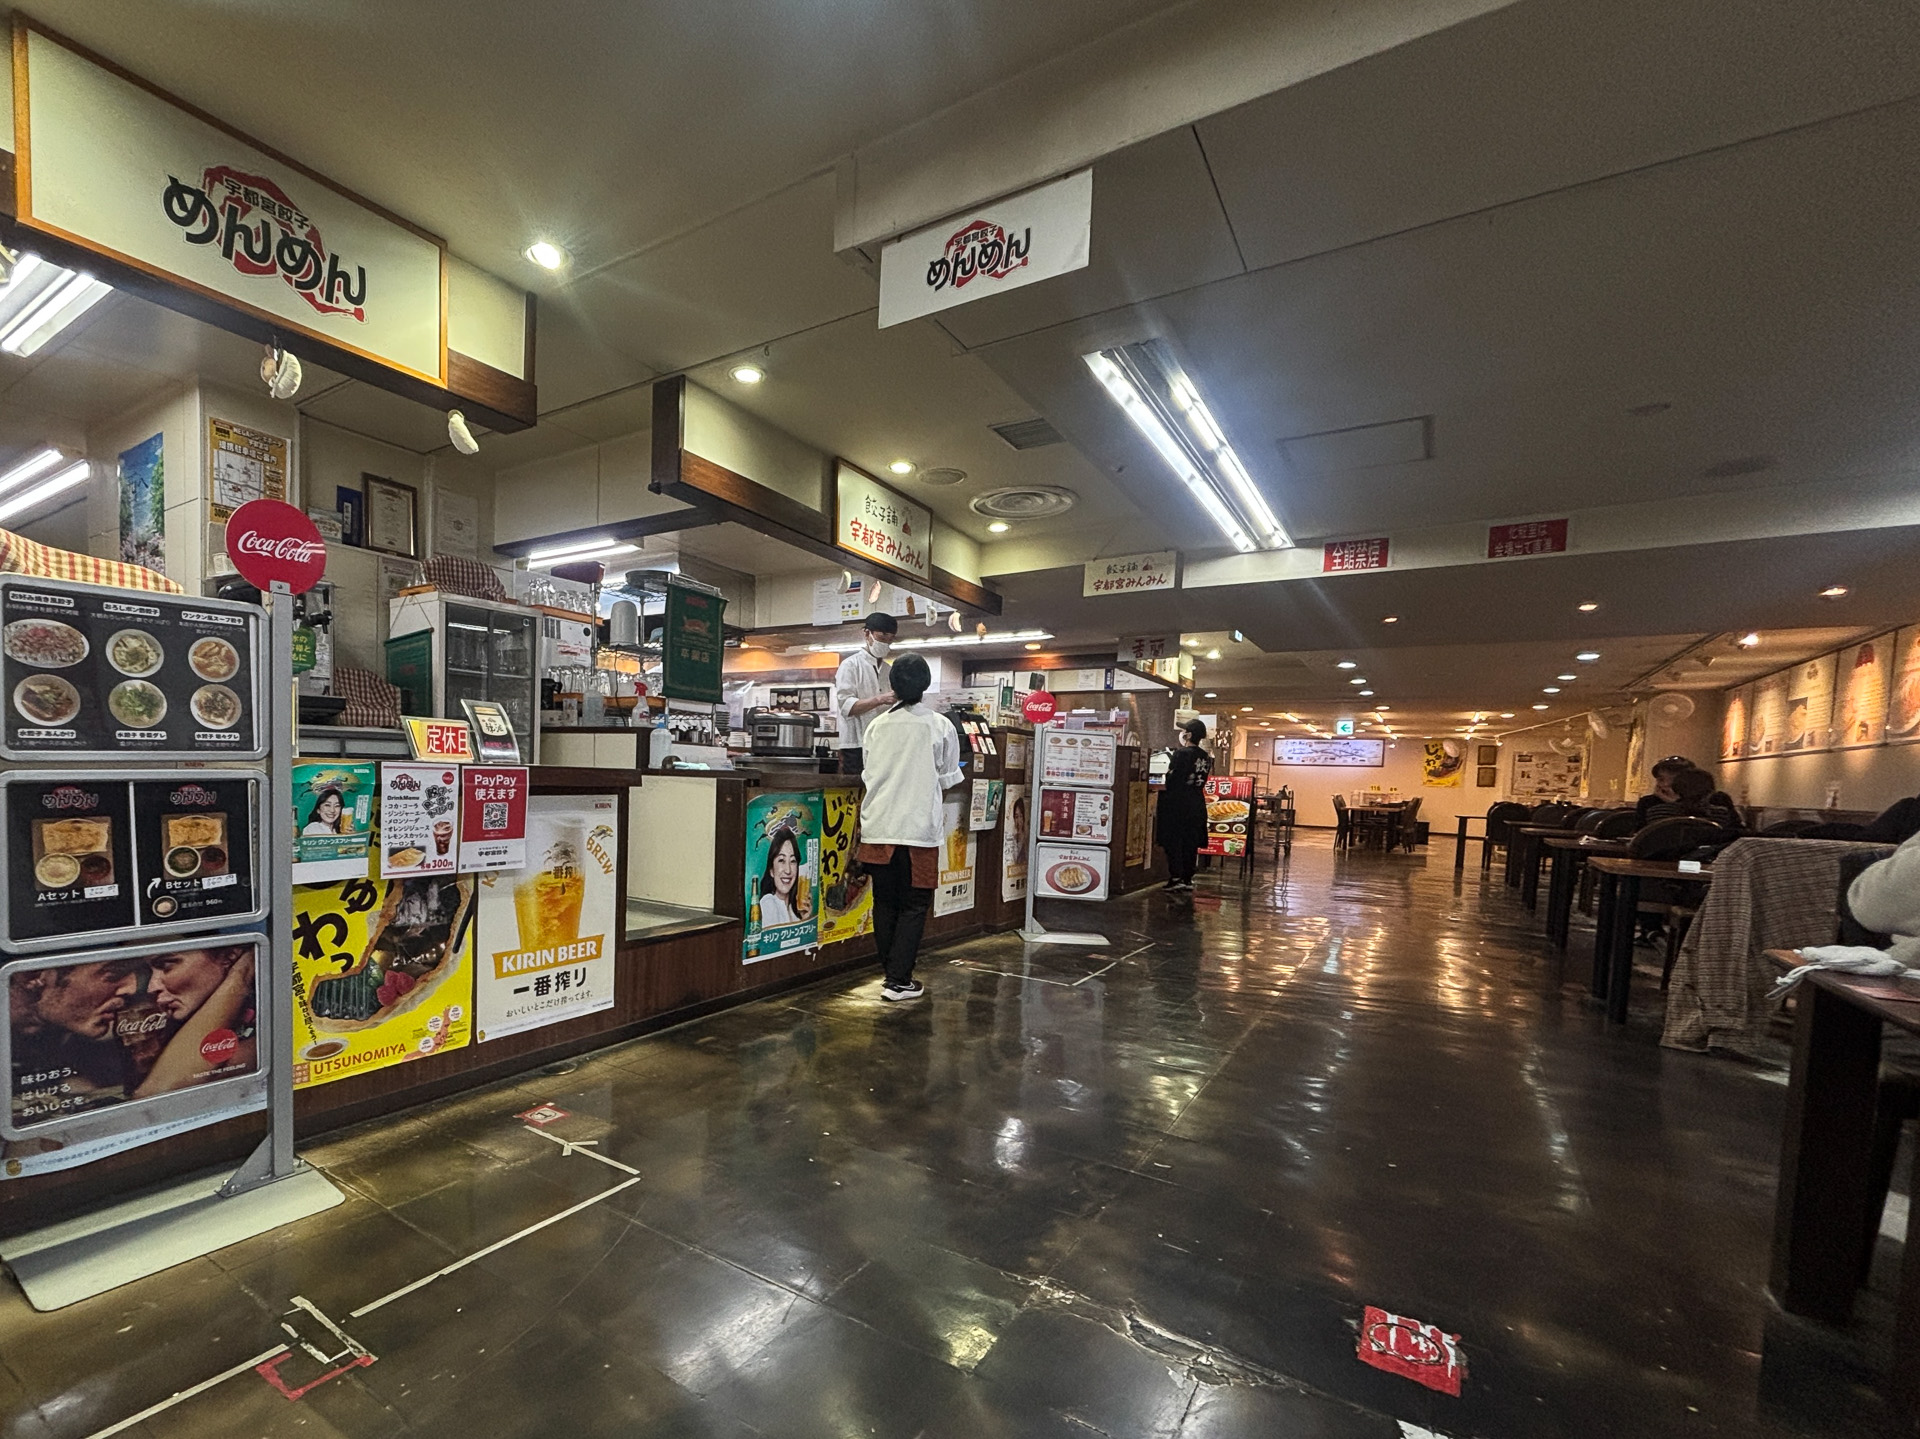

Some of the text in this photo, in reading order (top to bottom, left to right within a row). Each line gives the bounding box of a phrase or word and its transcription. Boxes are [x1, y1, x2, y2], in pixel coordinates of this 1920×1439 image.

[223, 177, 310, 230] 宇都宮餃子
[163, 174, 366, 306] めんめん
[954, 224, 998, 247] 宇都宮餃子
[926, 227, 1031, 291] めんめん
[865, 494, 899, 527] 餃子舗
[238, 530, 324, 563] Coca-Cola
[850, 517, 924, 571] 宇都宮みんみん
[1332, 540, 1381, 570] 全館禁煙
[1093, 573, 1167, 591] 宇都宮みんみん
[1026, 702, 1053, 712] Coca-Cola
[428, 726, 468, 754] 定休日
[474, 774, 517, 787] PayPay
[475, 788, 517, 801] 使えます
[586, 837, 615, 875] BREW
[37, 889, 80, 901] Aセット
[763, 925, 816, 943] キリン グリーンズフリー
[502, 941, 597, 973] KIRIN BEER
[513, 967, 587, 997] 一番搾り
[506, 990, 593, 1018] おいしいとこだけ搾ってます。
[117, 1012, 168, 1036] Coca-Cola
[201, 1038, 238, 1054] Coca-Cola
[313, 1043, 407, 1075] UTSUNOMIYA
[21, 1067, 78, 1085] 味わおう、
[22, 1083, 72, 1101] はじける
[22, 1096, 89, 1117] おいしさを。
